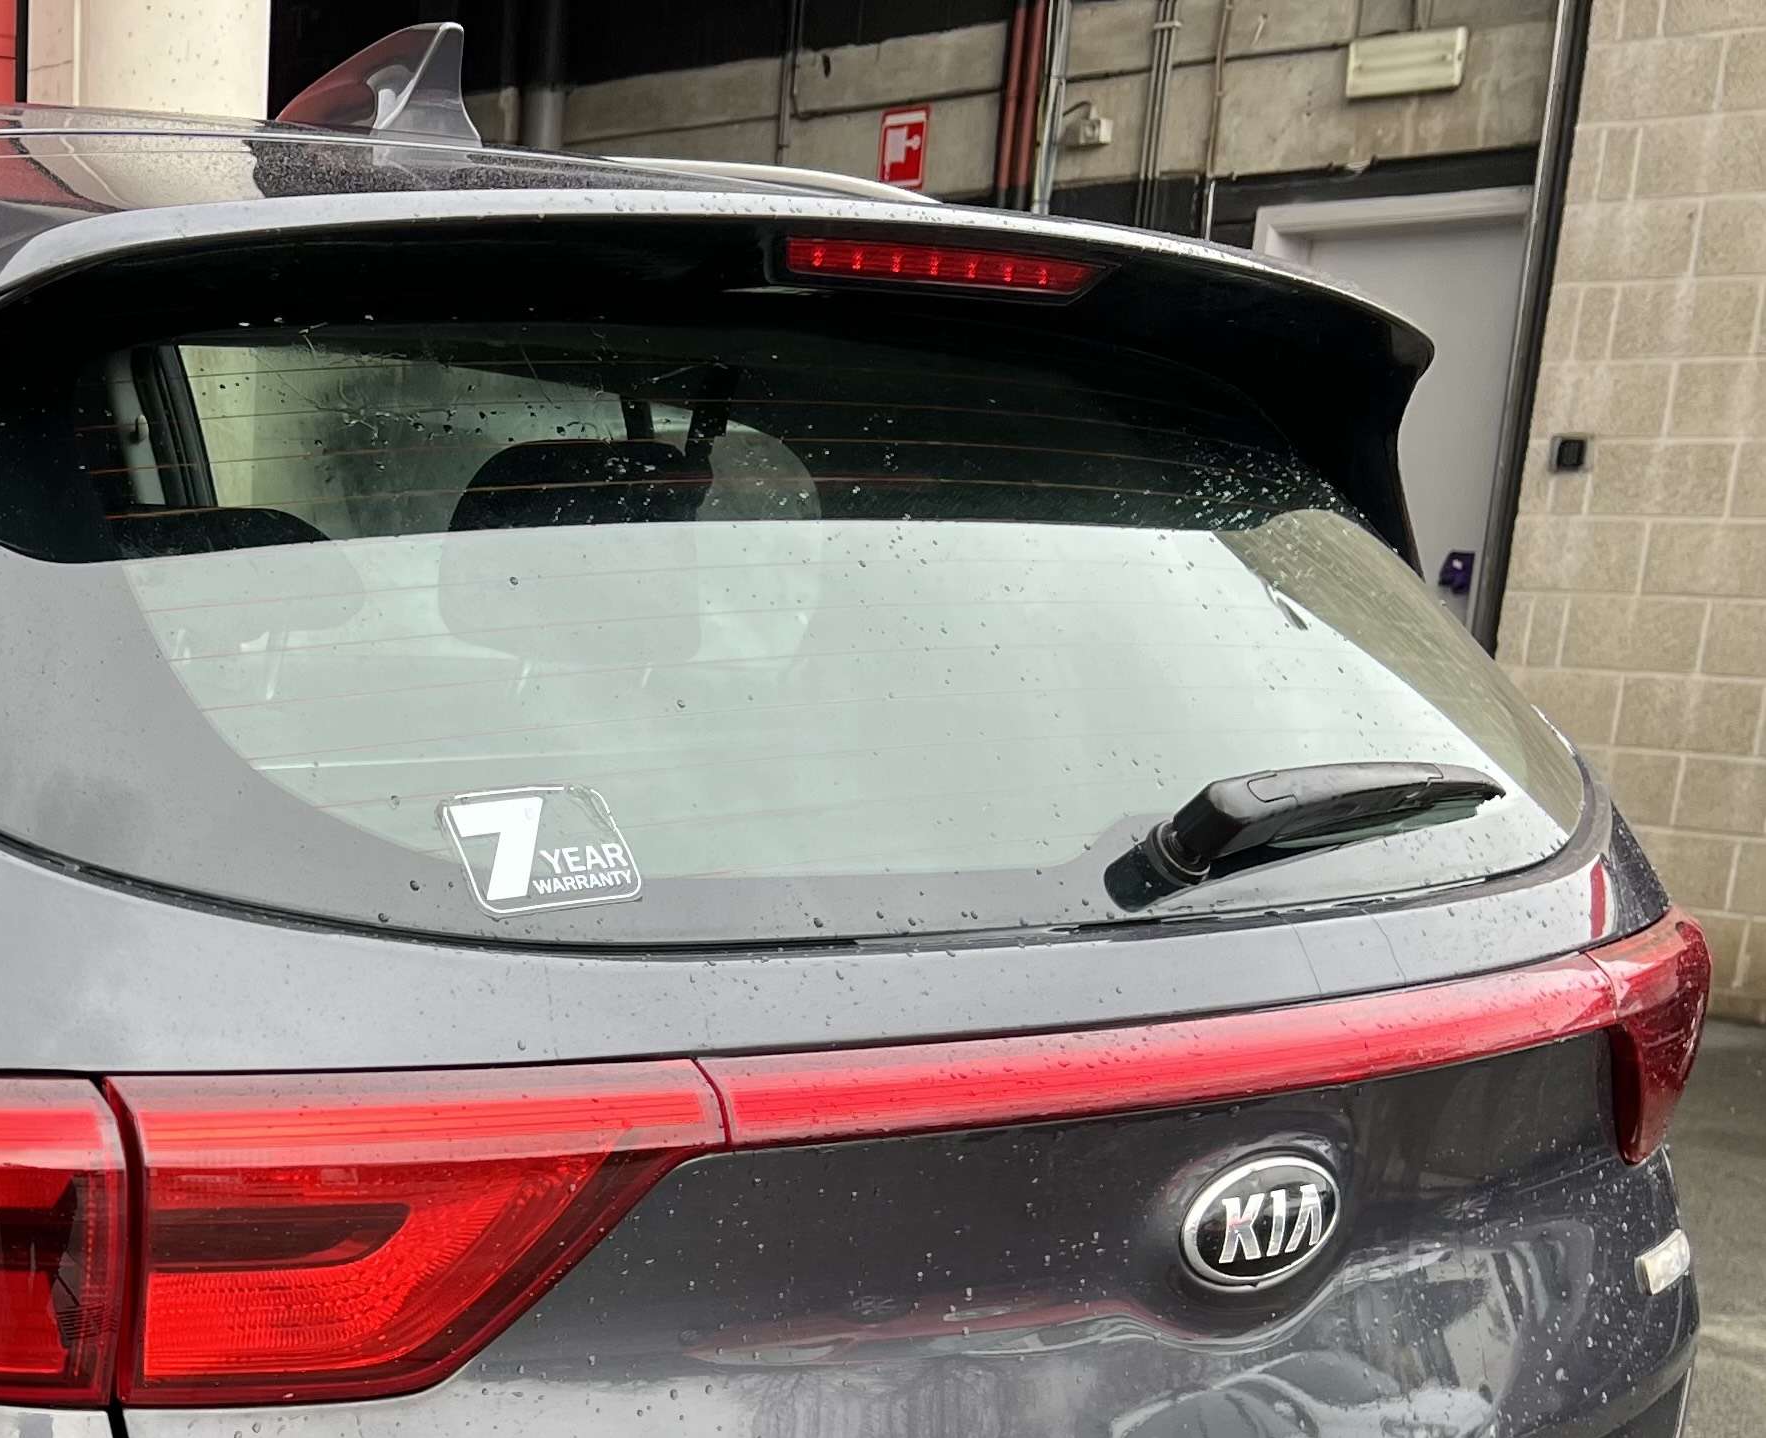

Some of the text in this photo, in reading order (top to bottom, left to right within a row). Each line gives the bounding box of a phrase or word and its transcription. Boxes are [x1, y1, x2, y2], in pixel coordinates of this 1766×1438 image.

[449, 796, 630, 901] 7 YEAR
[533, 869, 632, 896] WARRANTY
[1218, 1183, 1323, 1264] KIA
